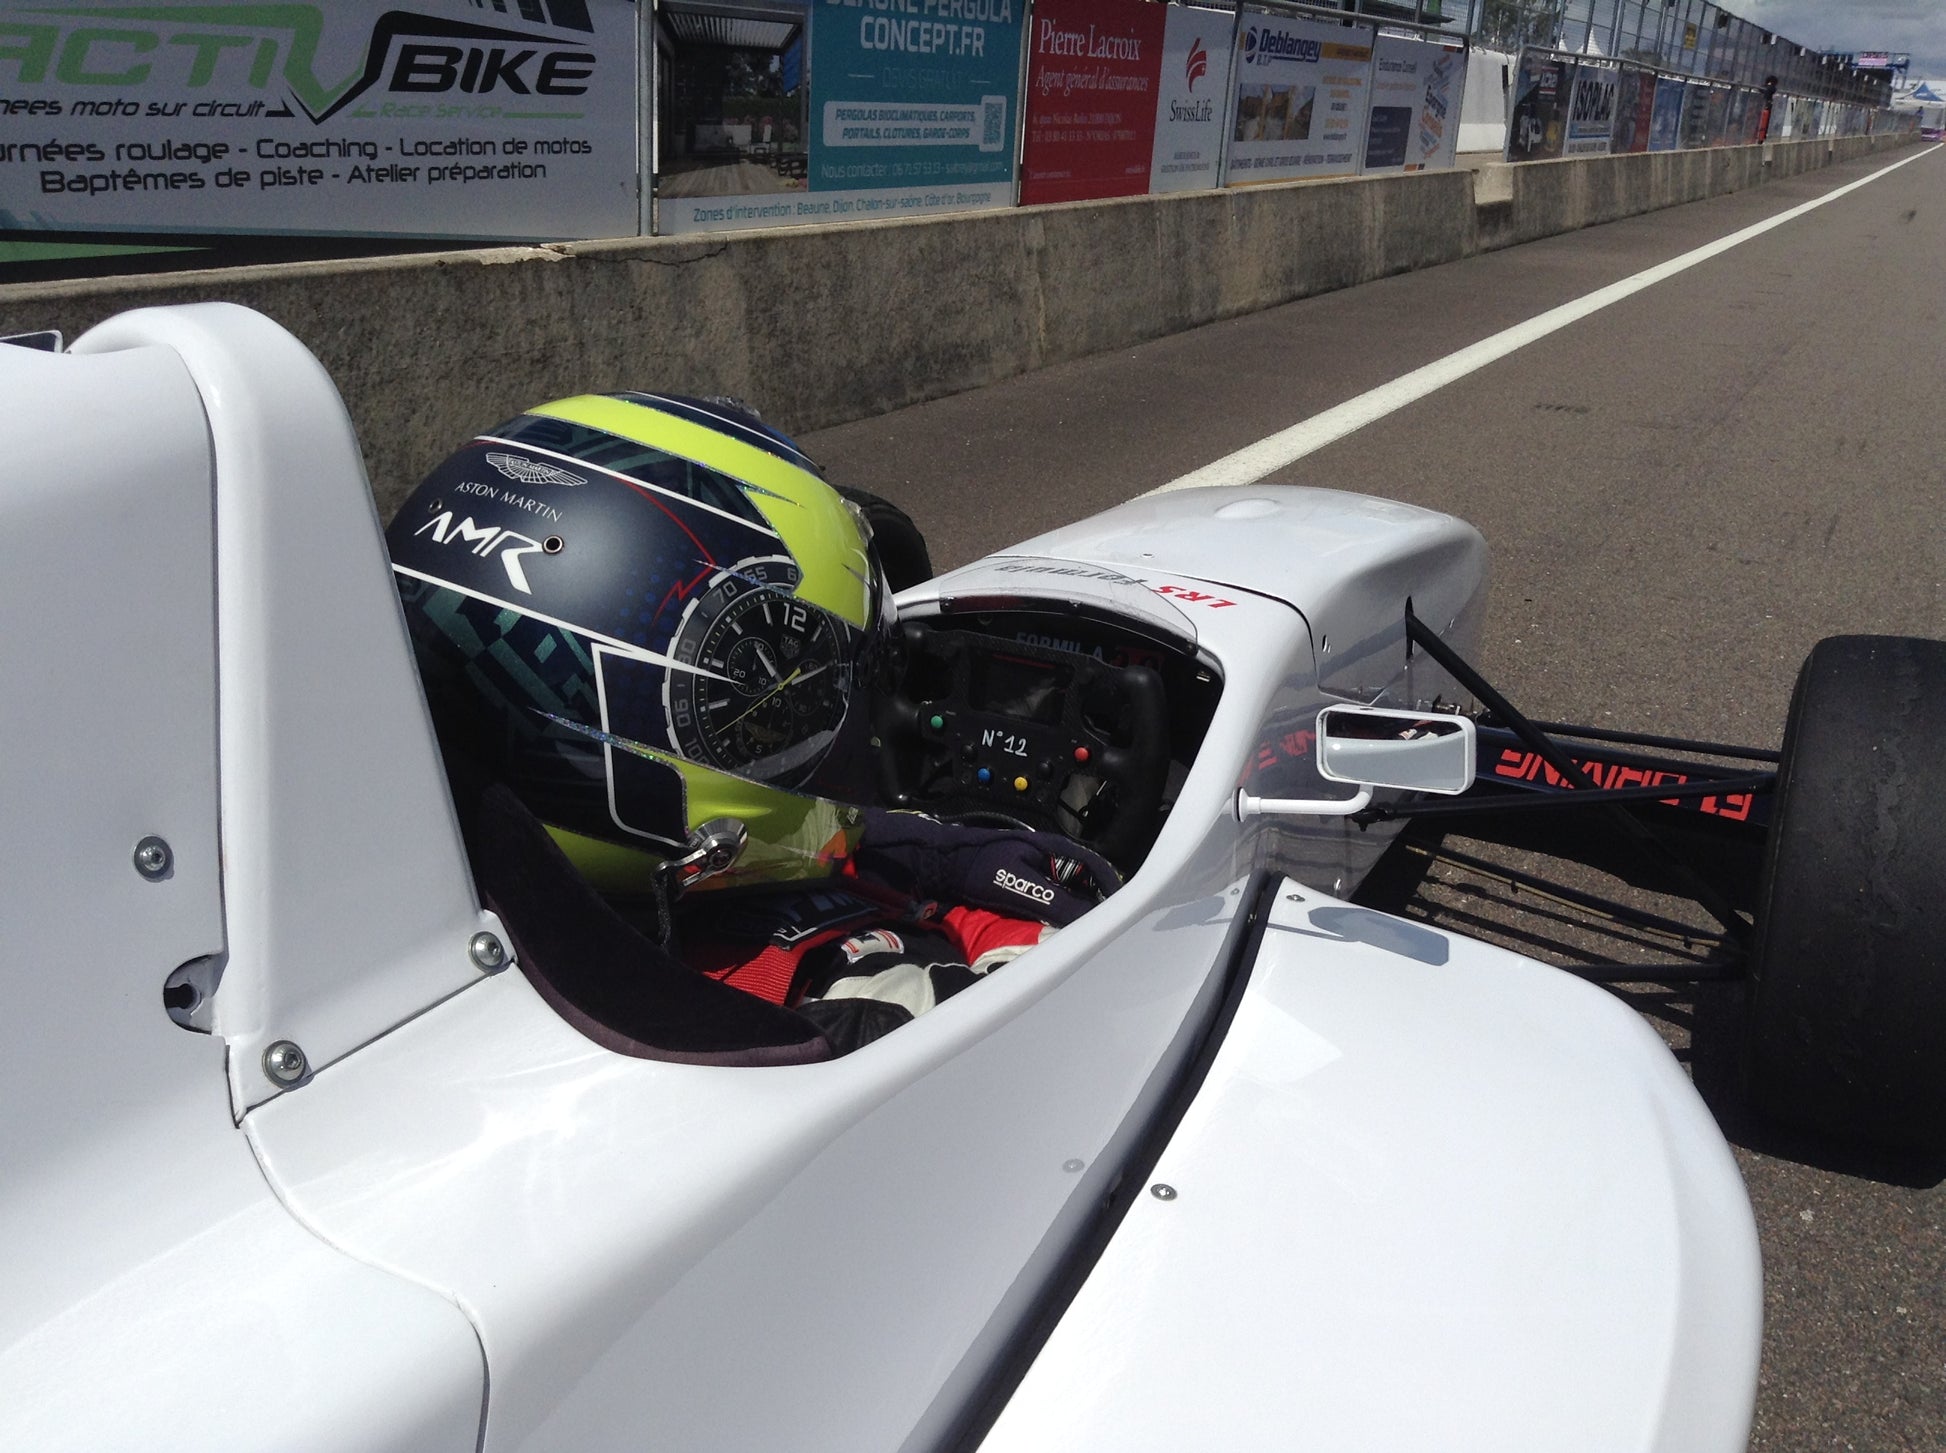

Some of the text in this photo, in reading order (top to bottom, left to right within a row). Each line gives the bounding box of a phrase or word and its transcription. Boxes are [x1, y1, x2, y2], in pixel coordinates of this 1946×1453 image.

[860, 15, 986, 57] CONCEPT.FR
[1038, 18, 1142, 61] Pierre Lacroix
[1258, 28, 1323, 63] Deblangey
[388, 44, 597, 96] BIKE
[1035, 65, 1065, 96] Agent
[70, 99, 140, 117] moto
[146, 101, 187, 118] sur
[192, 99, 266, 118] circuit
[380, 102, 431, 118] Race
[1169, 99, 1214, 123] SwissLife
[0, 138, 105, 162] rnées
[116, 140, 230, 164] roulage
[256, 138, 378, 161] Coaching
[400, 137, 497, 157] Location
[503, 137, 528, 155] de
[534, 137, 592, 155] motos
[40, 168, 206, 197] Baptêmes
[214, 167, 251, 189] de
[260, 166, 324, 190] piste
[347, 163, 421, 184] Atelier
[428, 161, 547, 186] préparation
[693, 207, 725, 222] Zones
[455, 480, 564, 524] ASTON MARTIN
[414, 510, 544, 596] AMR
[712, 581, 738, 603] 70
[1150, 584, 1238, 609] LRS
[783, 602, 807, 633] 12
[674, 698, 692, 728] 90
[993, 866, 1056, 903] sparco
